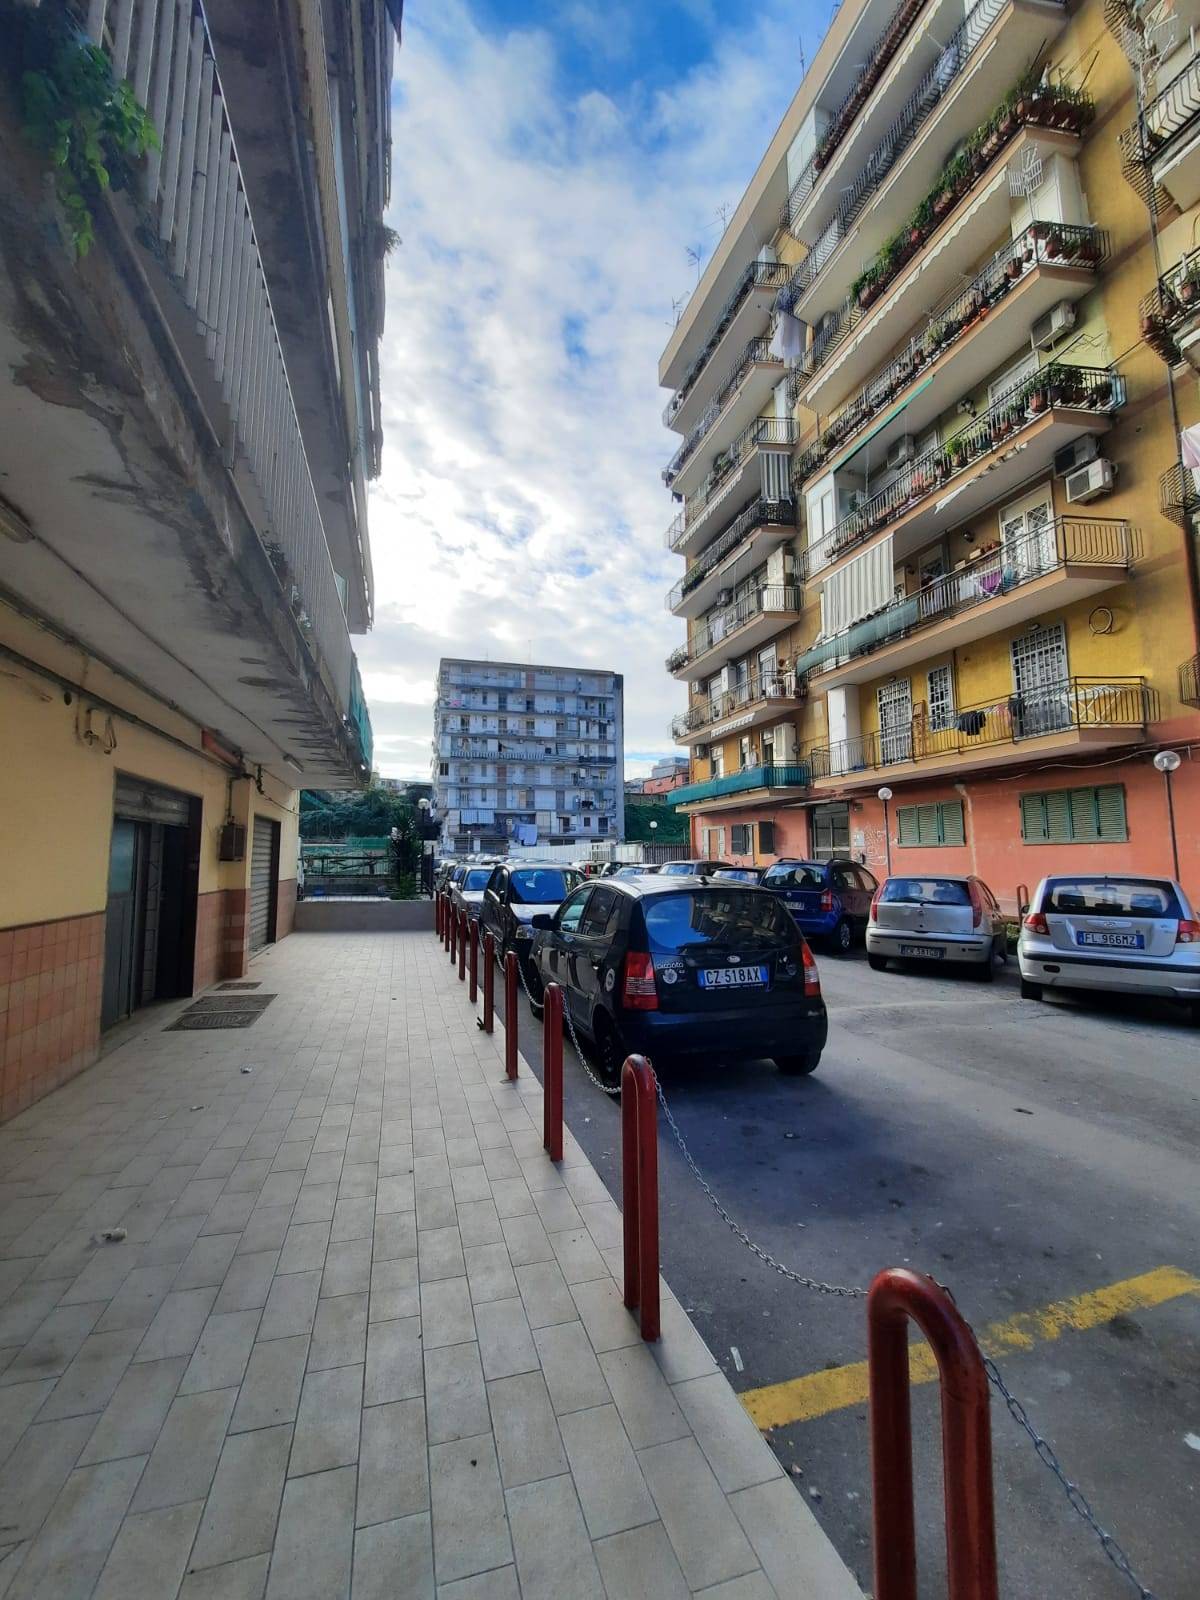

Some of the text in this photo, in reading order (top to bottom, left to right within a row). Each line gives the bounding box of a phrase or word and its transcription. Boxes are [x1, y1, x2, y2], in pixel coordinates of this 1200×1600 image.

[1085, 933, 1097, 943] FL
[706, 967, 760, 984] CZ 518AX
